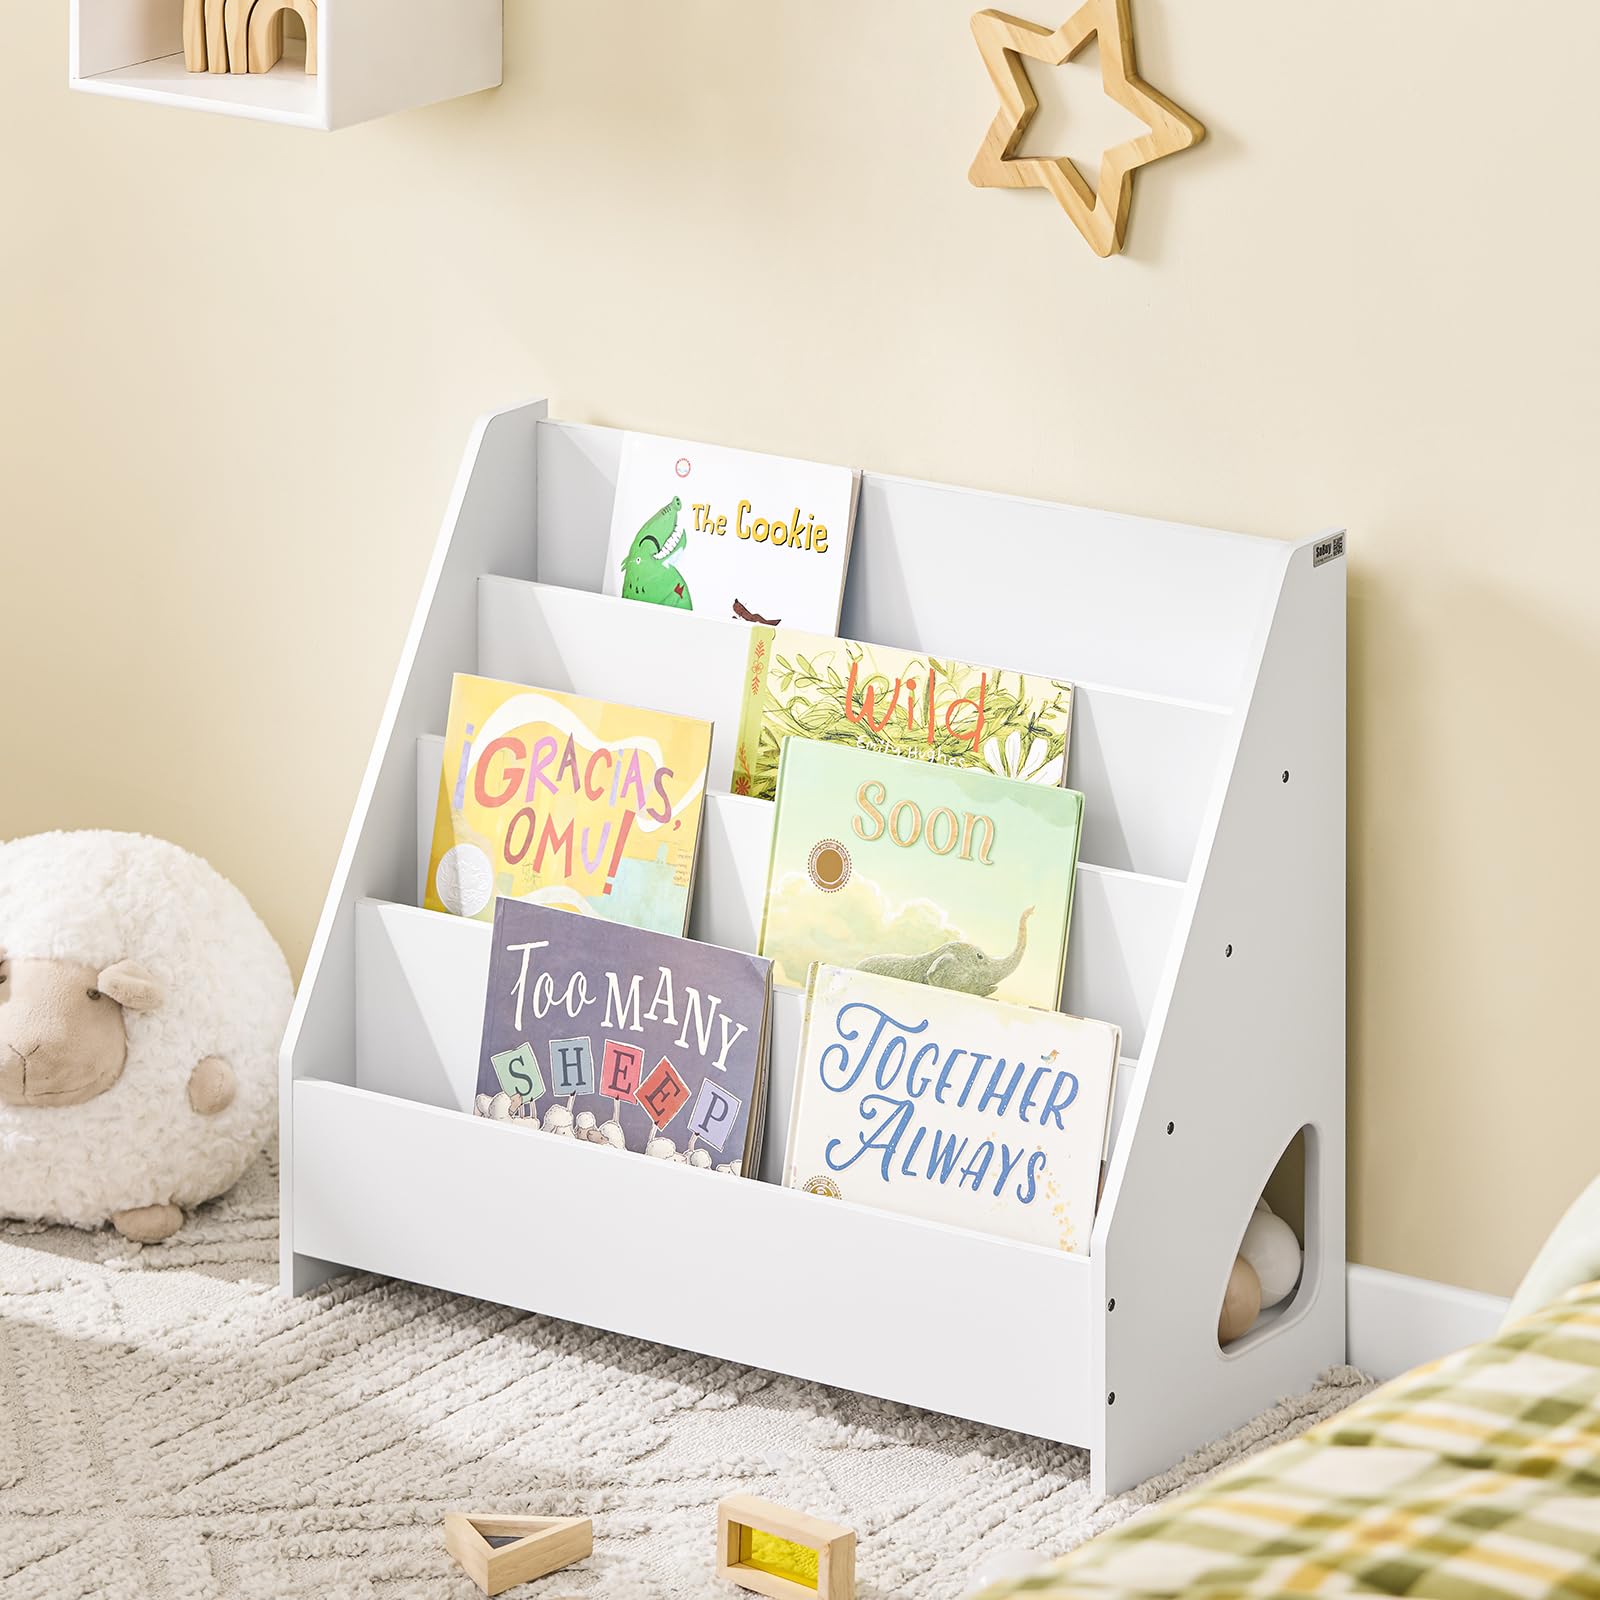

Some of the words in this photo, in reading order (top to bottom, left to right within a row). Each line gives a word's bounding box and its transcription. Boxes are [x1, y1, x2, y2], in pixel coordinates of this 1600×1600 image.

[692, 503, 727, 536] The
[735, 499, 829, 554] Cookie
[845, 662, 987, 752] Wild
[908, 746, 966, 768] Hughes
[504, 807, 636, 895] OMU!
[852, 780, 994, 865] Soon
[507, 941, 597, 1031] Too
[600, 966, 748, 1072] MANY
[508, 1047, 729, 1133] SHEEP
[820, 1002, 1079, 1130] TOGETHER
[825, 1094, 1046, 1204] ALWAYS
